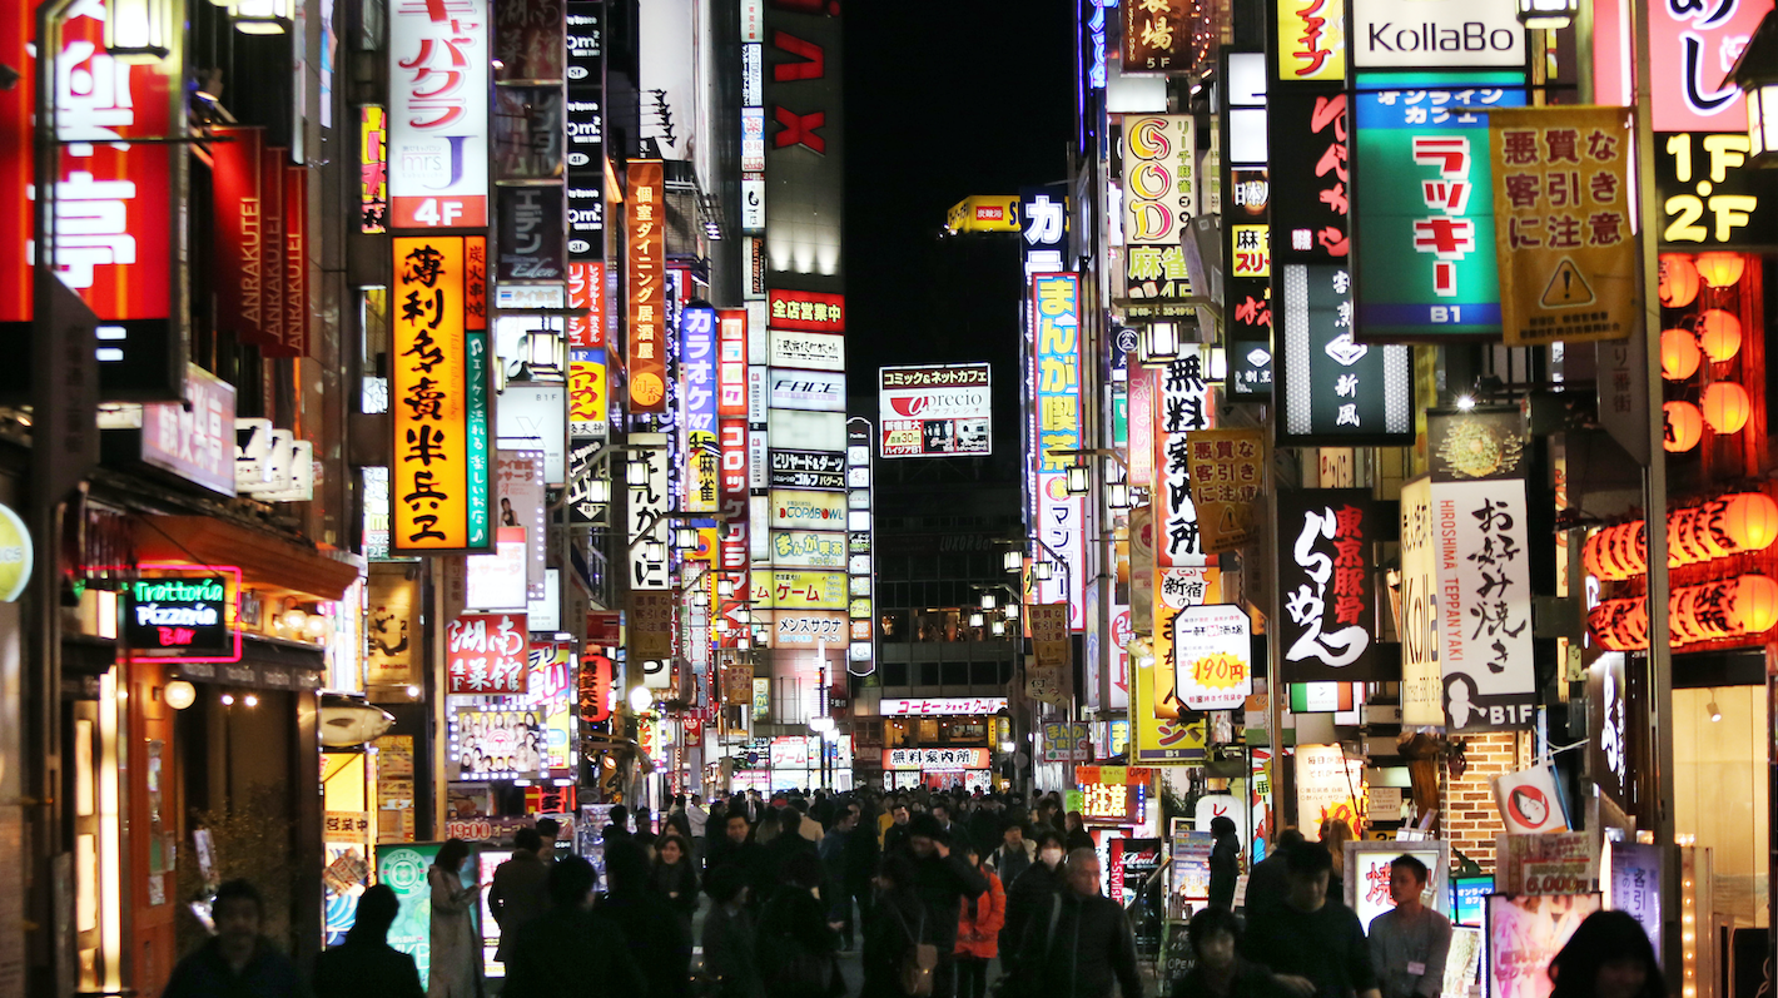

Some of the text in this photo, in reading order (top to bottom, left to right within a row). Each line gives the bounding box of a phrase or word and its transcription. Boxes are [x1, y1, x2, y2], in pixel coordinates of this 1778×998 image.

[1368, 21, 1514, 52] KollaBo
[397, 0, 482, 130] キャバクラ
[1147, 58, 1171, 68] 5F
[1377, 88, 1503, 106] オンライン
[1177, 121, 1192, 194] リーチ麻雀
[1503, 128, 1618, 164] 悪質な
[1666, 133, 1750, 183] 1F
[1129, 117, 1174, 241] GOD
[1505, 171, 1618, 208] 客引き
[414, 199, 463, 226] 4F
[515, 190, 542, 254] エデン
[1412, 135, 1475, 297] ラッキー
[1664, 194, 1757, 243] 2F
[1508, 211, 1623, 250] に注意
[241, 197, 260, 324] ANRAKUTEI
[636, 186, 655, 359] 個室ダイニング居酒屋
[467, 246, 487, 319] 炭火串焼
[772, 299, 841, 323] 全店営業中
[1430, 305, 1461, 323] B1
[683, 308, 712, 410] カラオケ
[774, 379, 842, 394] FACE
[884, 370, 988, 386] コミック&ネットカフェ
[1039, 279, 1078, 471] まんが喫茶
[908, 389, 983, 416] aprecio
[1335, 373, 1361, 428] 新風
[772, 453, 845, 472] ビリヤード&ダーツ
[1193, 441, 1255, 461] 悪質な
[699, 453, 715, 502] 麻雀
[1195, 463, 1256, 483] 客引き
[774, 533, 843, 557] まんが喫茶
[1440, 500, 1457, 570] HIROSHIMA
[1333, 504, 1365, 625] 東京豚骨
[133, 578, 224, 602] Trattoria
[776, 583, 820, 601] ゲーム
[1164, 577, 1204, 598] 新宿
[1467, 497, 1527, 674] お好み焼き
[451, 615, 524, 656] 湖南
[778, 617, 842, 633] メンズサウナ
[1195, 659, 1244, 681] 190円
[898, 701, 941, 713] コーヒー
[1489, 704, 1533, 725] B1F
[774, 753, 806, 764] ゲーム
[890, 748, 972, 765] 無料案内所
[326, 817, 368, 831] 営業中
[1526, 876, 1588, 894] 6,000円
